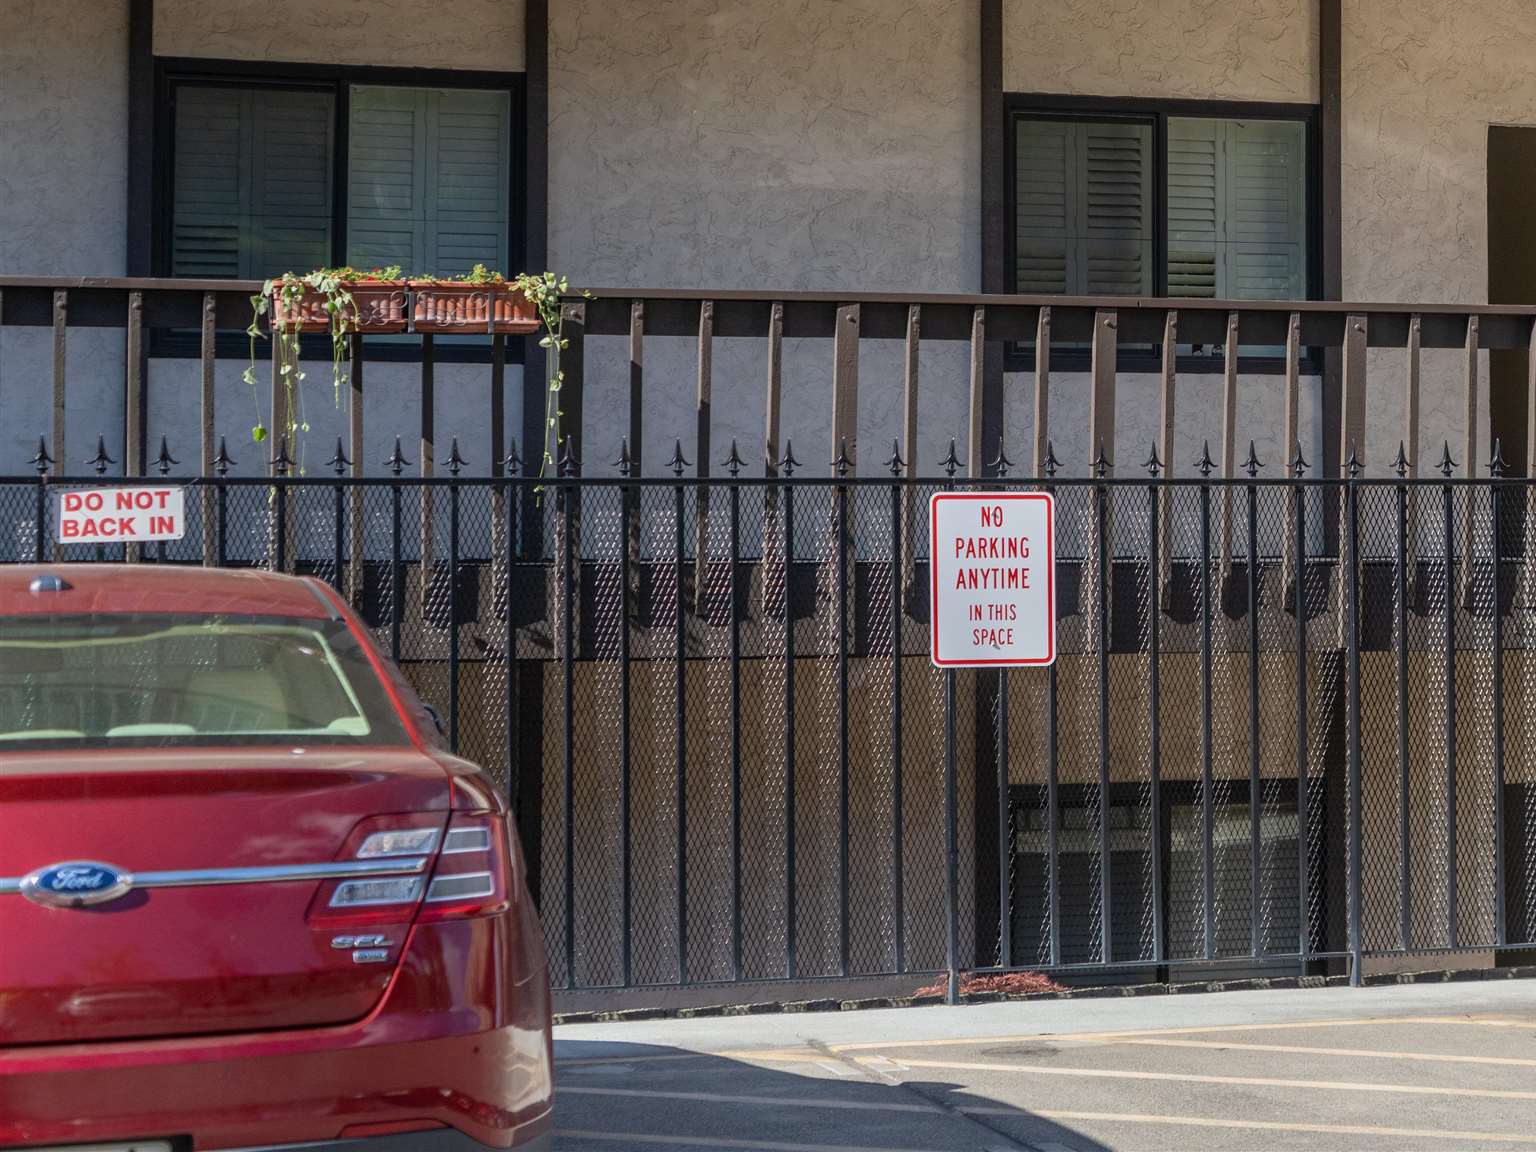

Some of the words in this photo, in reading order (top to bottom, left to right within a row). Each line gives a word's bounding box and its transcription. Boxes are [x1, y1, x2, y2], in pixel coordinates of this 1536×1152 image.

[64, 493, 104, 512] DO
[116, 491, 170, 510] NOT
[62, 517, 137, 537] BACK
[150, 516, 174, 534] IN
[981, 506, 1003, 528] NO
[955, 537, 1030, 559] PARKING
[956, 568, 1031, 590] ANYTIME
[969, 604, 982, 621] IN
[987, 604, 1017, 621] THIS
[973, 628, 1014, 645] SPACE
[52, 868, 104, 890] Ford
